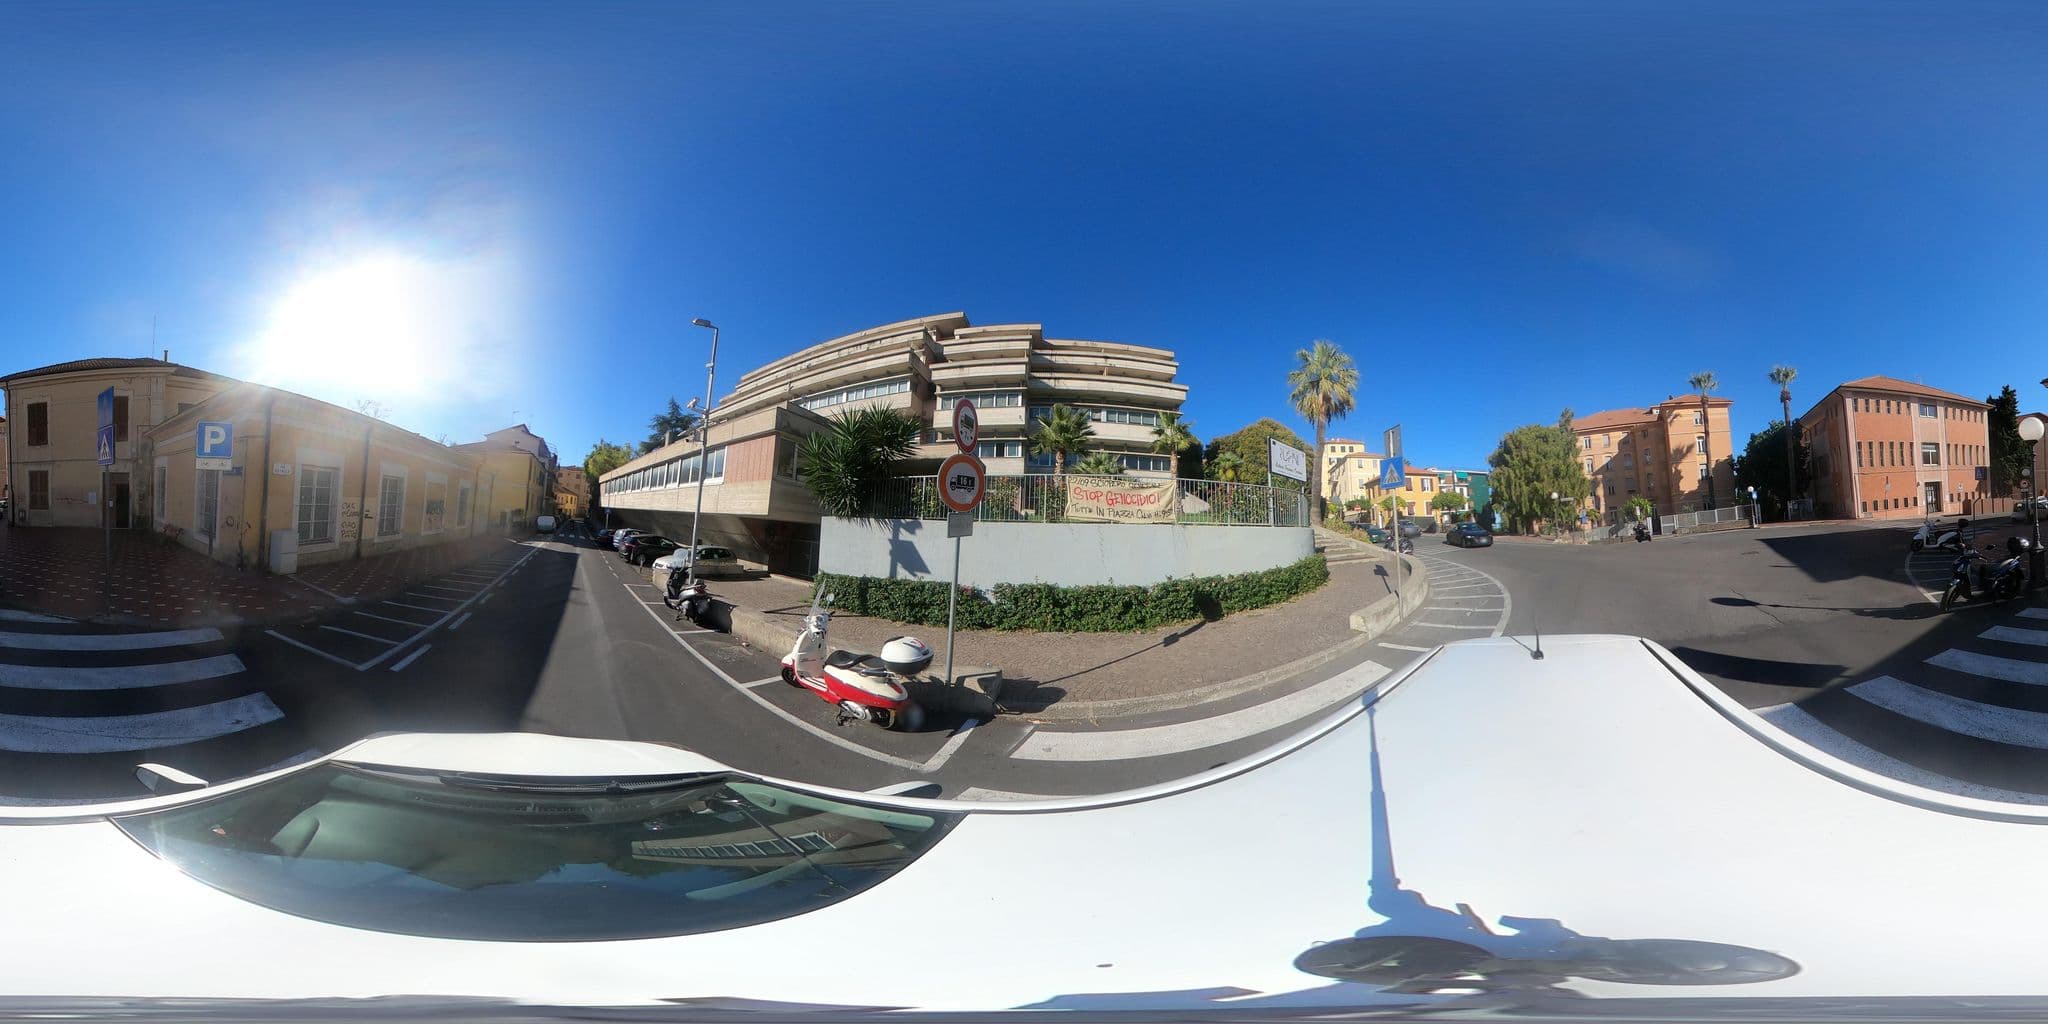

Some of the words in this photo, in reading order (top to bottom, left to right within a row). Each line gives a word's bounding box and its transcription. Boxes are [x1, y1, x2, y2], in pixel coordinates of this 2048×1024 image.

[204, 425, 226, 453] P
[1073, 487, 1103, 502] STOP
[1096, 505, 1105, 517] IN
